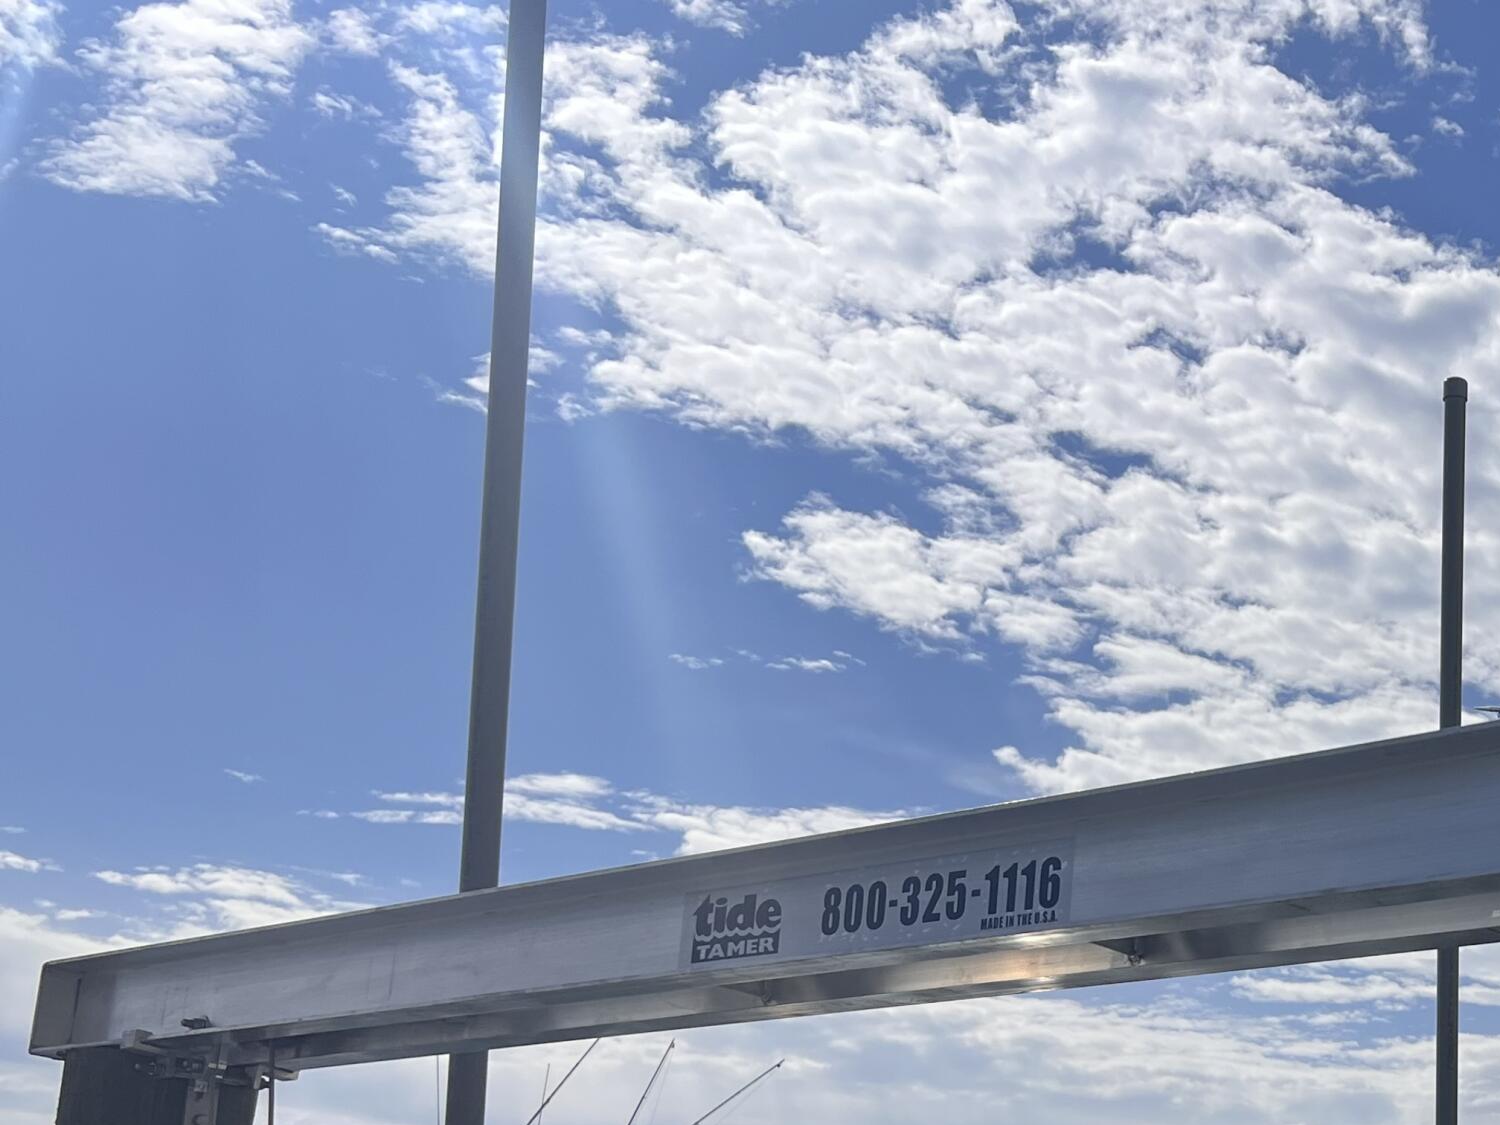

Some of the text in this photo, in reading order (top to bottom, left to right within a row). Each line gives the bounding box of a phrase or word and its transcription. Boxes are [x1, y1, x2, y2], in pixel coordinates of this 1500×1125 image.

[821, 856, 1062, 936] 800-325-1116
[693, 894, 782, 937] tide
[980, 916, 1004, 930] MADE
[1005, 915, 1015, 928] IN
[1017, 913, 1033, 926] THE
[697, 937, 775, 960] TAMER
